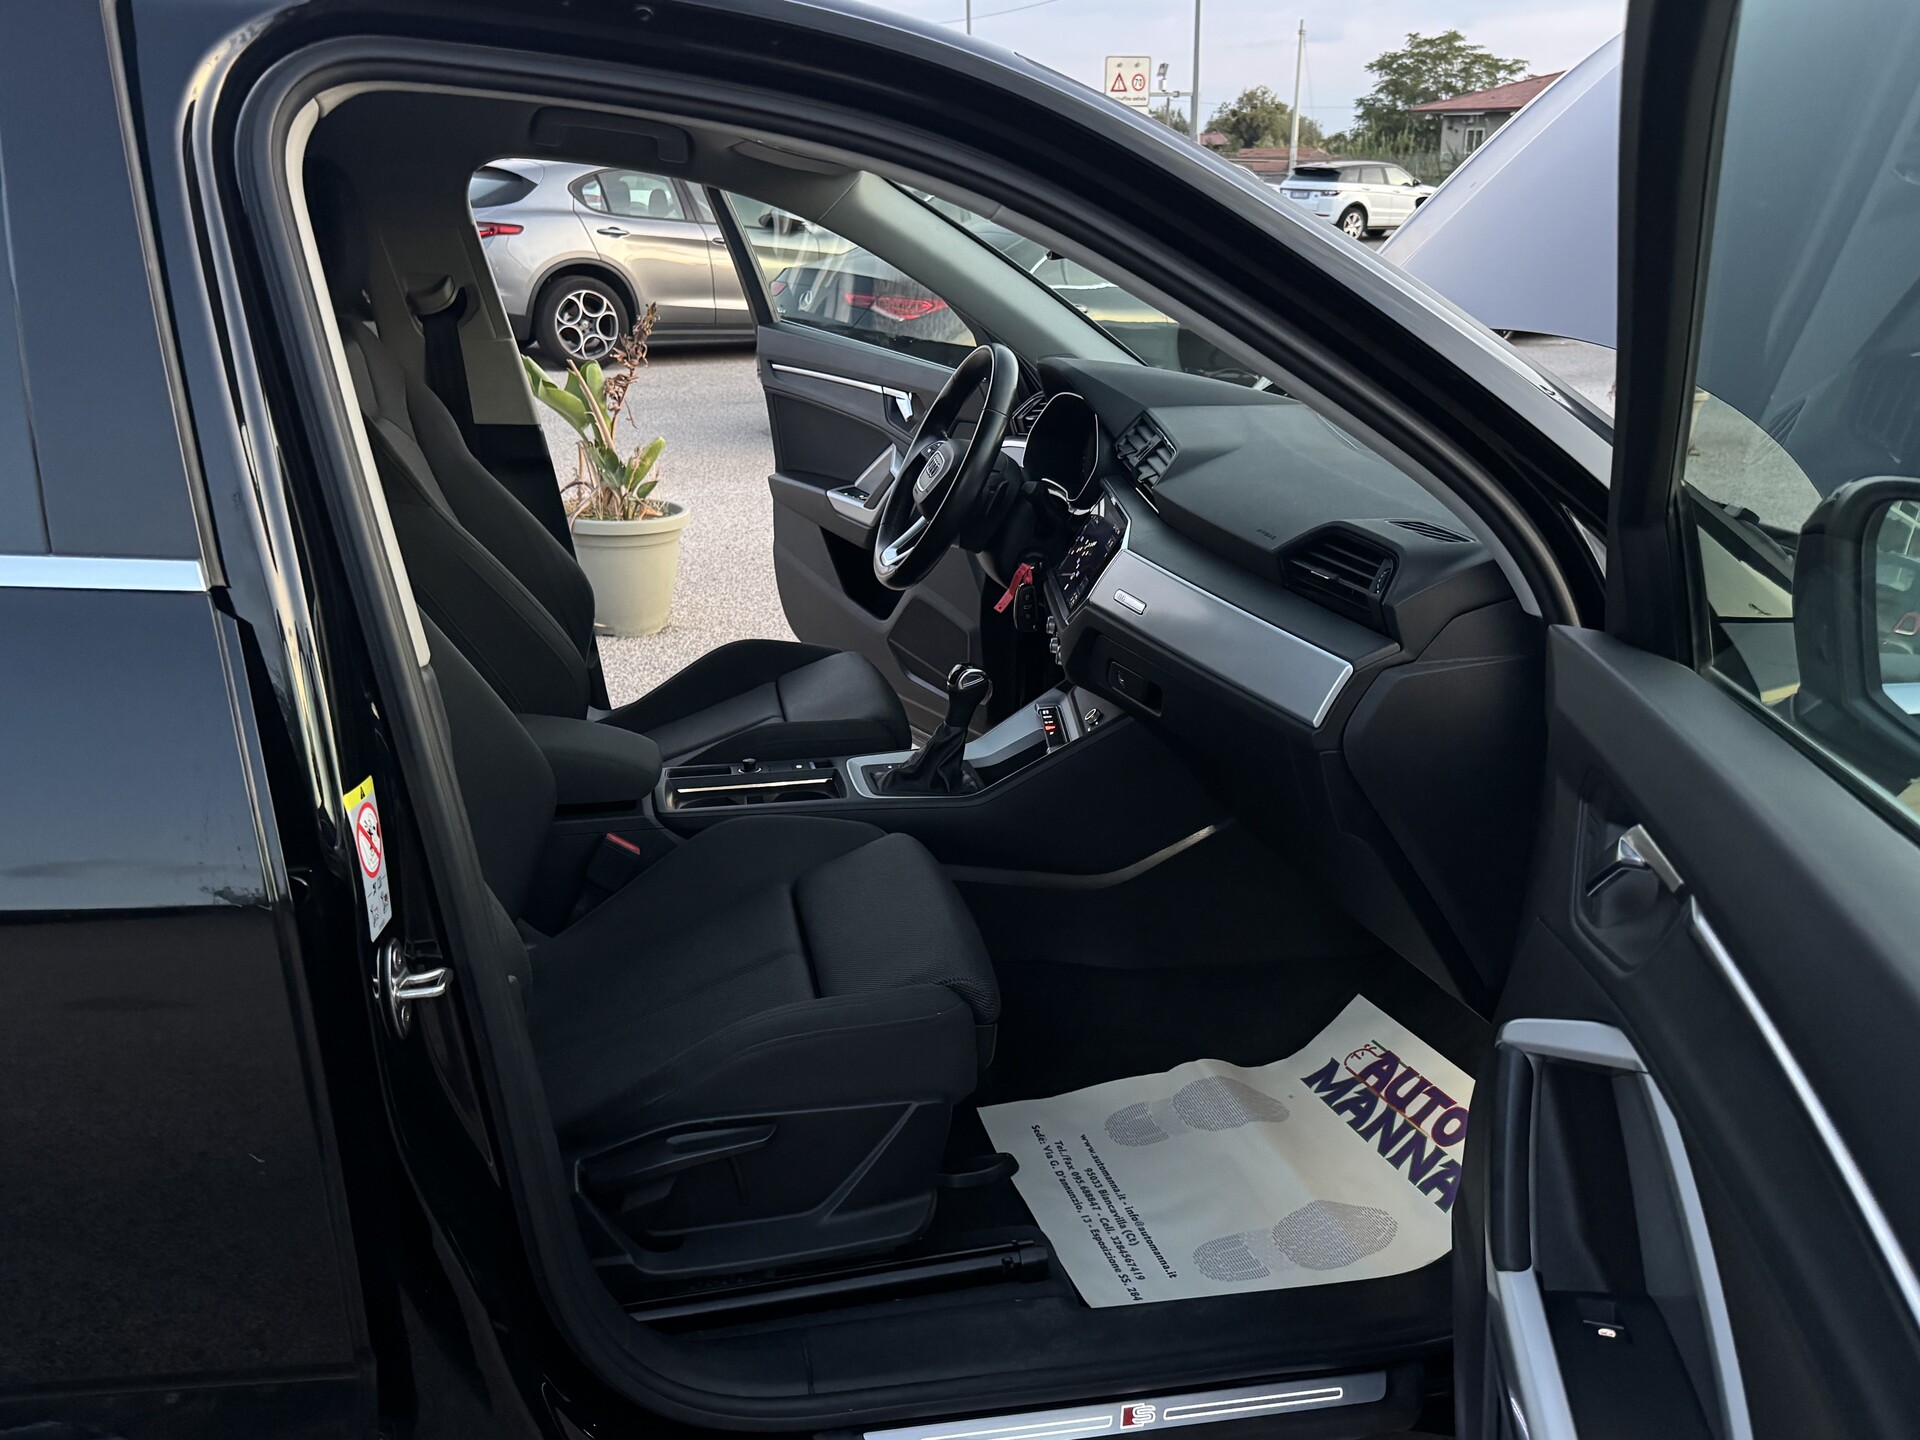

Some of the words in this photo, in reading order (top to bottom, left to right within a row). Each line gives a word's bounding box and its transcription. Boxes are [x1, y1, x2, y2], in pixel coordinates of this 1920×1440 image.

[1300, 1057, 1462, 1214] MANNA
[1358, 1050, 1469, 1147] AUTO
[1031, 1124, 1046, 1145] Sede:
[1043, 1144, 1054, 1160] Via
[1049, 1159, 1060, 1170] G.
[1080, 1214, 1093, 1223] 13
[1089, 1228, 1122, 1273] Esposizione
[1117, 1273, 1132, 1287] SS.
[1126, 1287, 1144, 1301] 284
[1054, 1139, 1075, 1171] Tel./Fax
[1099, 1217, 1116, 1235] Cell.
[1080, 1133, 1127, 1201] www.automanna.it
[1124, 1205, 1178, 1279] info@automanna.it
[1083, 1167, 1103, 1189] 95033
[1097, 1189, 1128, 1230] Biancavilla
[1121, 1229, 1140, 1247] (Ct)
